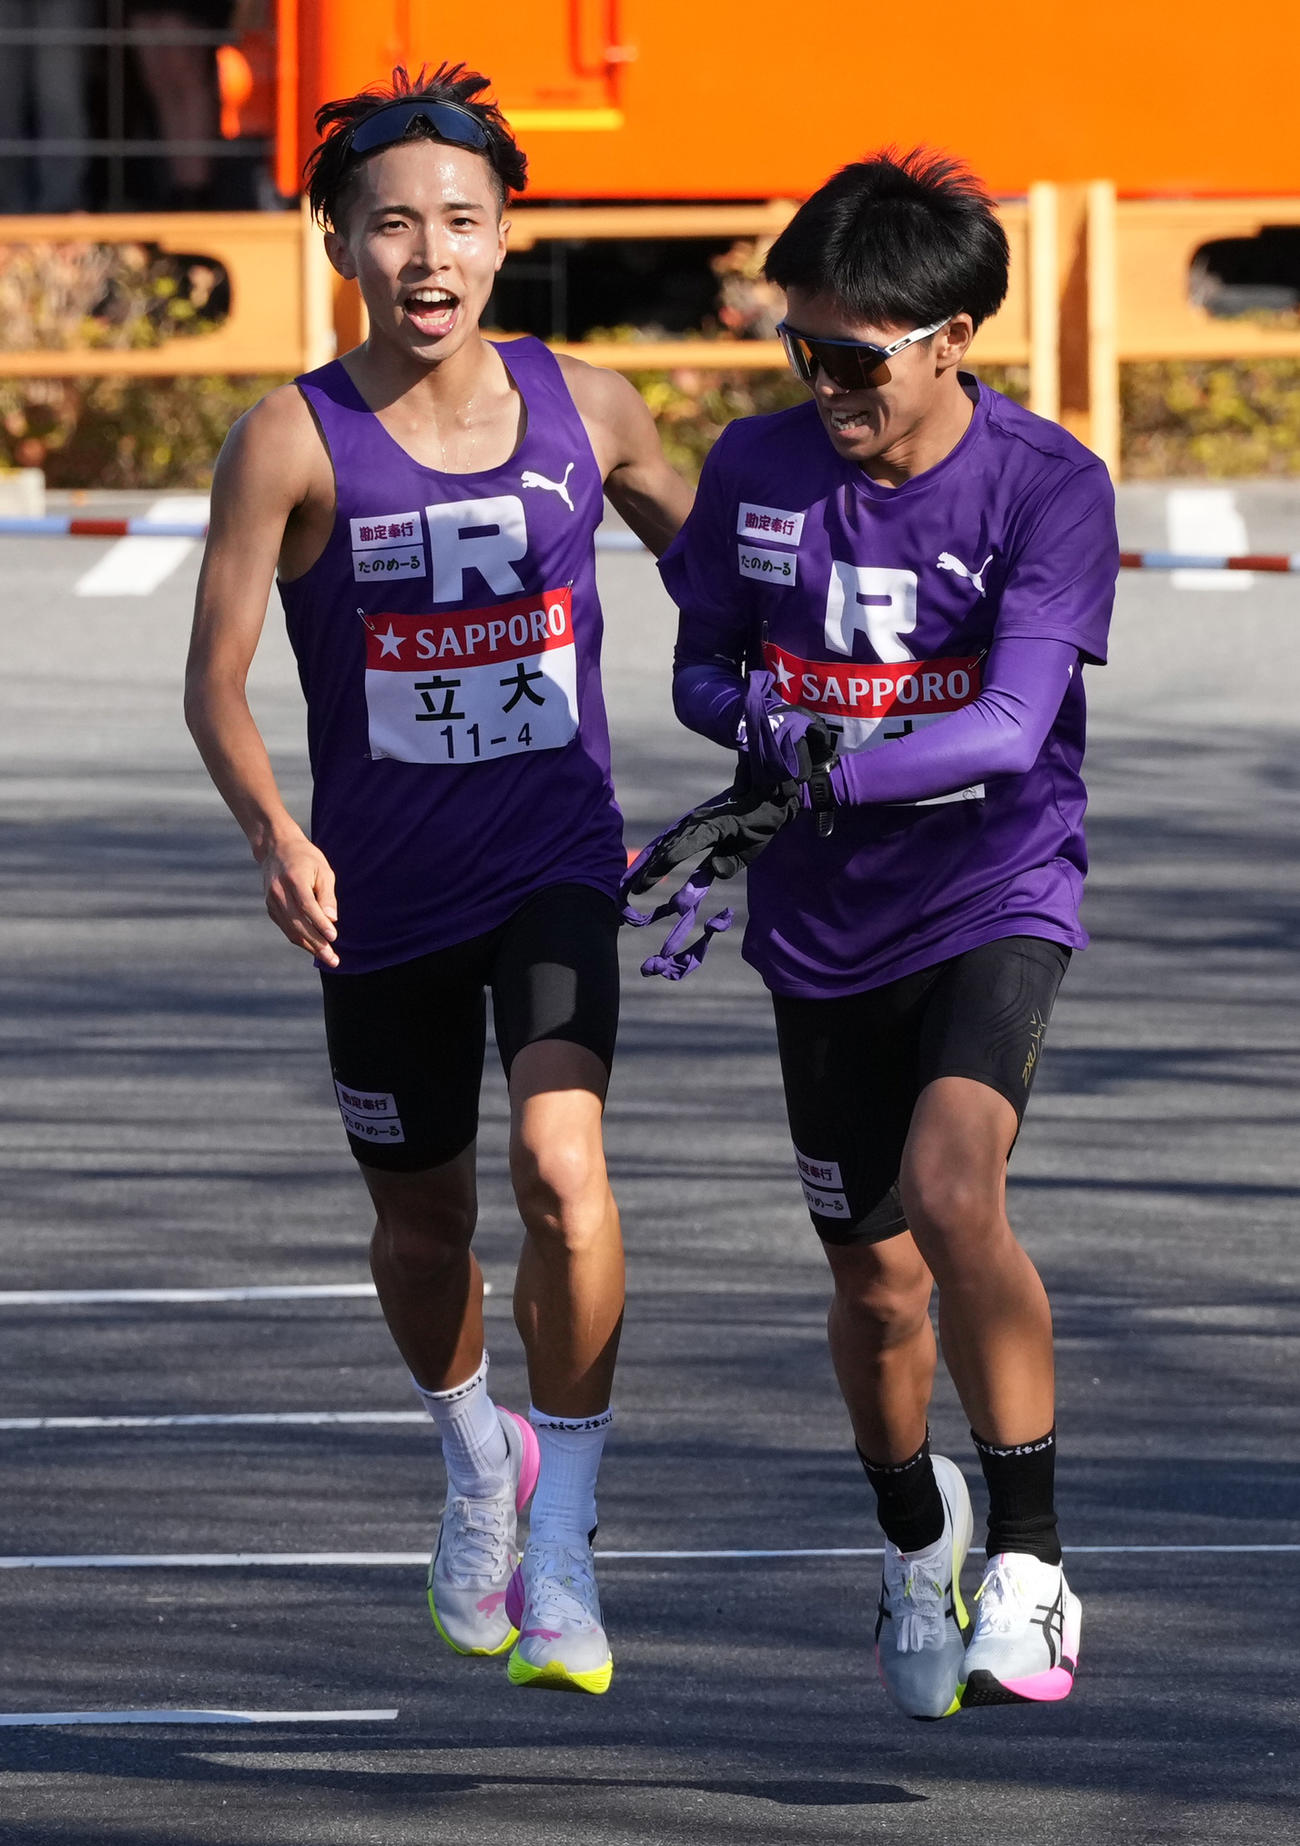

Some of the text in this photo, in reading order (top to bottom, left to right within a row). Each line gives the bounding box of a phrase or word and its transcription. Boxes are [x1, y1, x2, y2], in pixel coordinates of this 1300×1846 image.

[360, 521, 414, 541] 勘定奉行
[745, 511, 795, 536] 勘定奉行
[425, 495, 528, 602] R
[358, 555, 420, 574] たのめーる
[741, 555, 791, 576] たのめーる
[824, 561, 918, 663] R
[415, 603, 566, 660] SAPPORO
[801, 669, 970, 706] SAPPORO
[344, 1115, 400, 1136] たのめーる
